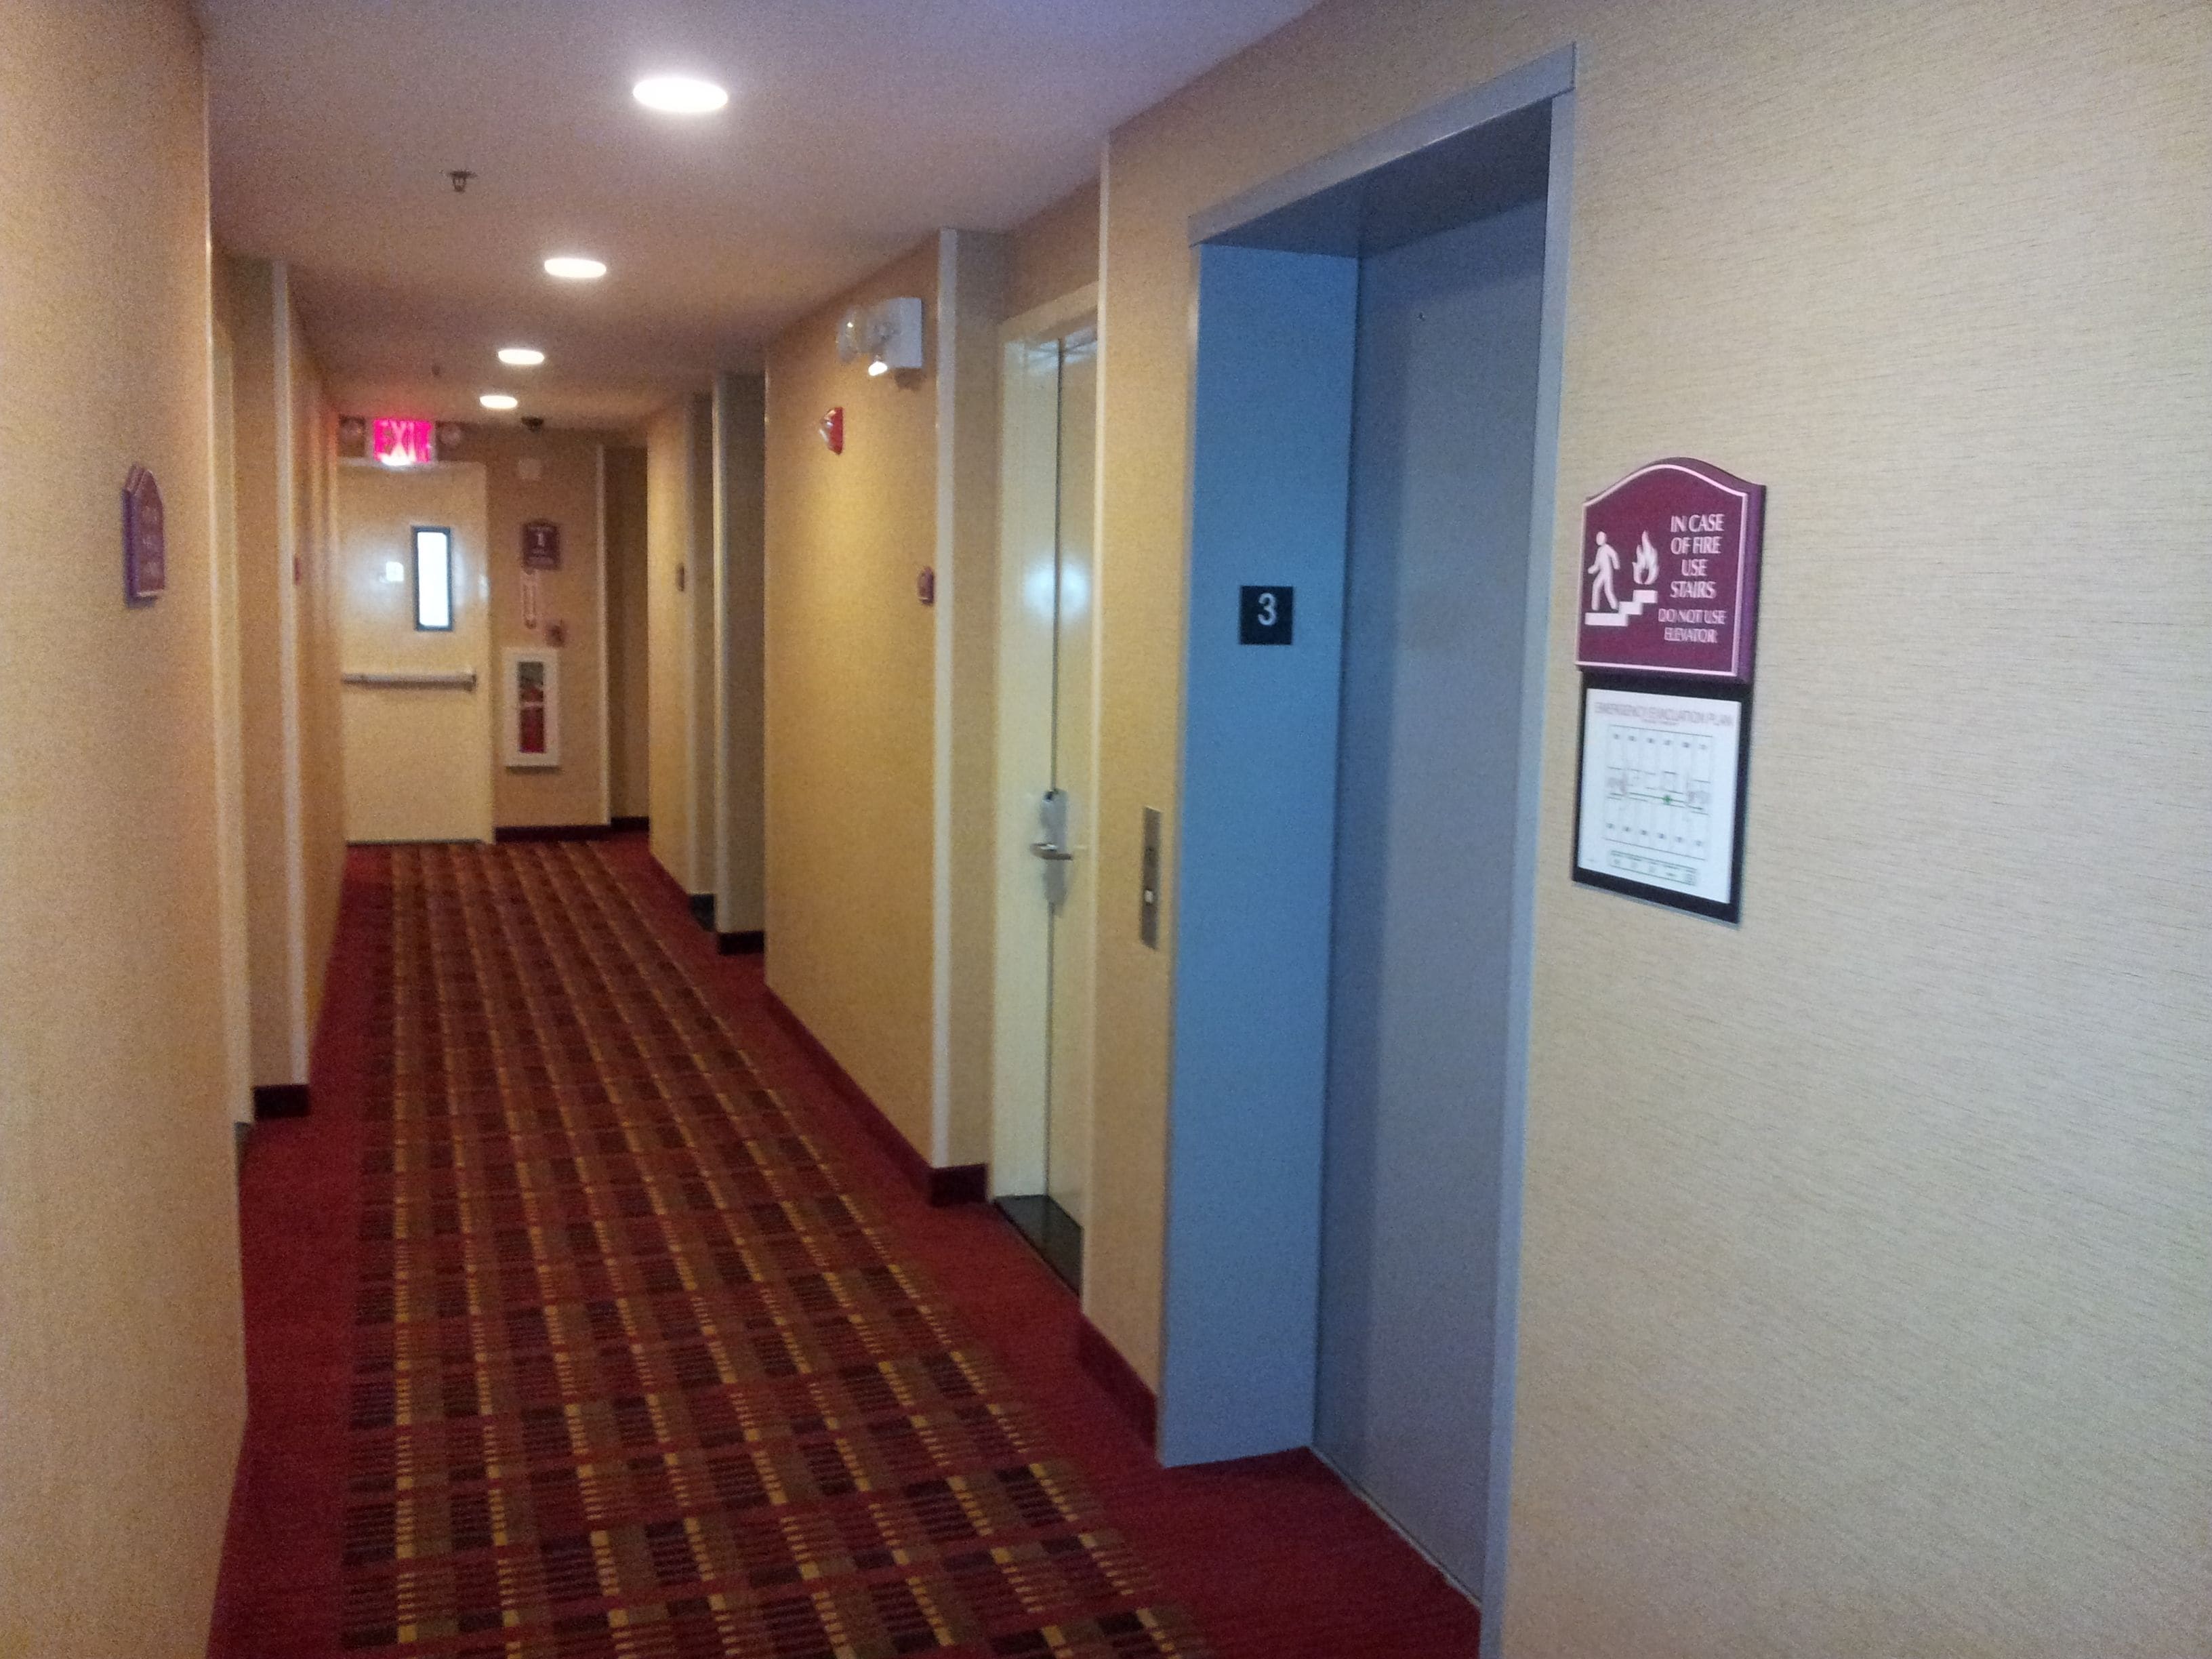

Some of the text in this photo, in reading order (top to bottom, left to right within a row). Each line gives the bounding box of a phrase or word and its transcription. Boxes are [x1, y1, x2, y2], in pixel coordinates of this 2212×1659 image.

[375, 419, 432, 462] EXIT
[1671, 513, 1725, 532] IN CASE
[1671, 536, 1722, 554] OF FIRE
[1681, 558, 1708, 576] USE
[1670, 581, 1717, 598] STAIRS
[1257, 592, 1277, 626] 3
[1658, 609, 1727, 624] DO NOT USE
[1664, 627, 1717, 643] ELEVATOR
